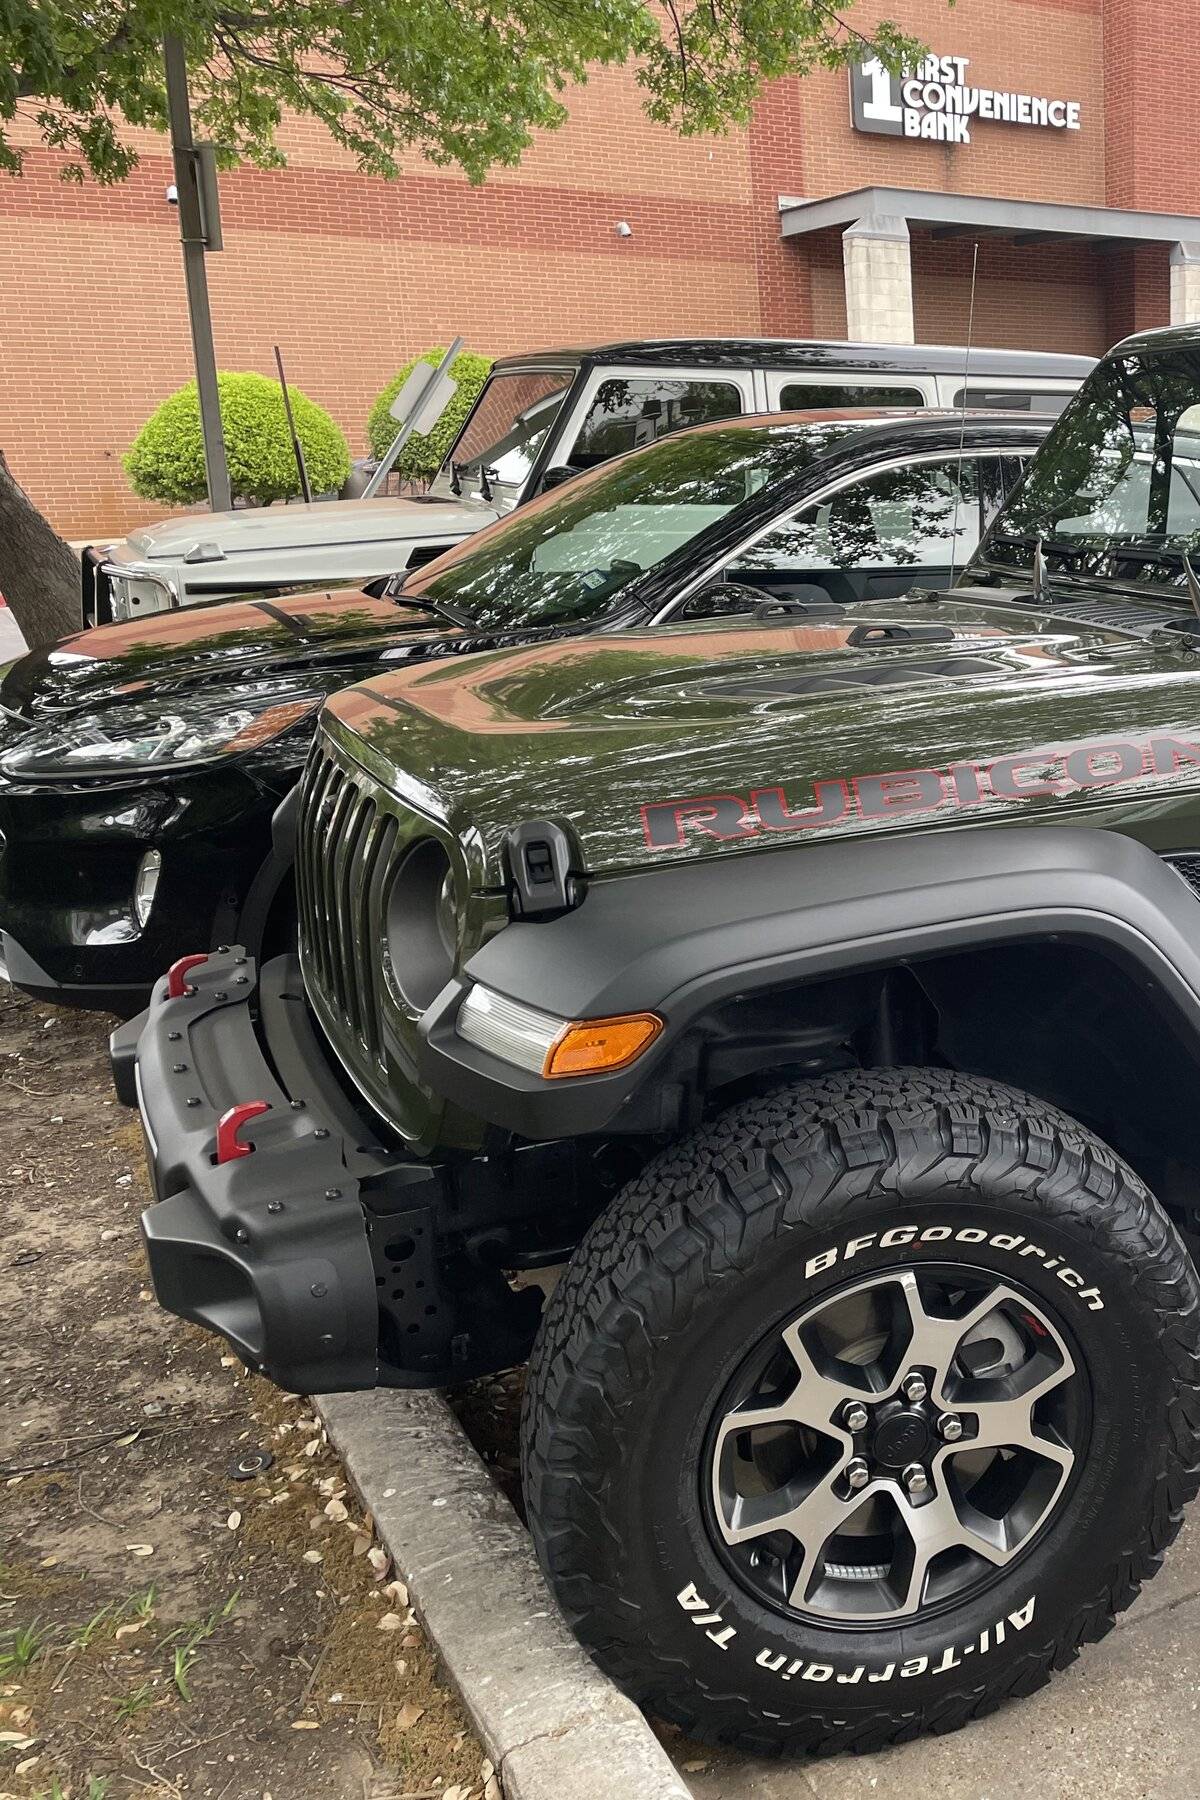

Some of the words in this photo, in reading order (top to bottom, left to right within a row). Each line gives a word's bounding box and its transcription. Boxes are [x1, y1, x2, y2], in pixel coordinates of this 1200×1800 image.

[903, 79, 1081, 129] CONVENIENCE
[904, 107, 971, 143] BANK
[804, 1224, 1105, 1311] BFGoodrich
[675, 1580, 738, 1651] T/A
[754, 1595, 1037, 1684] All-Terrain
